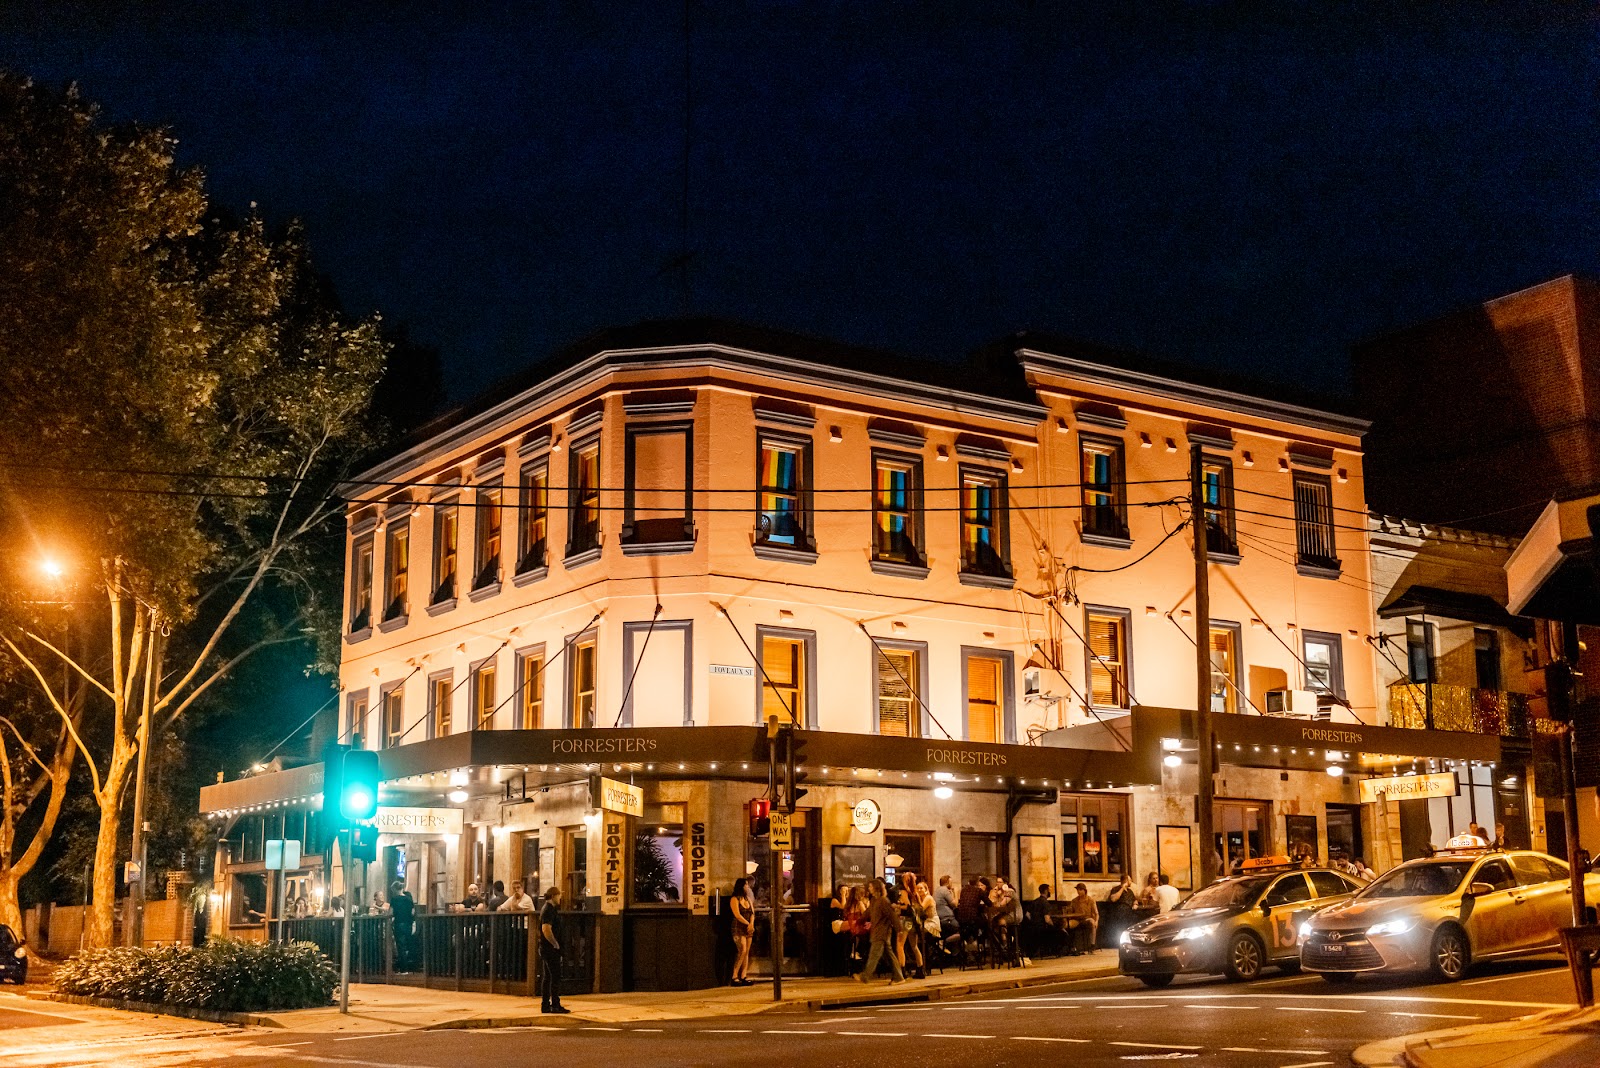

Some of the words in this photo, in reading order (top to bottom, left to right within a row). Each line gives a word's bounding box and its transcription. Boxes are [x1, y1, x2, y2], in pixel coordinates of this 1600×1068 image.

[714, 666, 743, 675] FOVEAUX
[358, 813, 445, 827] ORRESTER's
[772, 815, 788, 824] ONE
[773, 827, 788, 836] WAY
[606, 824, 620, 896] BOTTLE
[691, 822, 705, 896] SHOPPE
